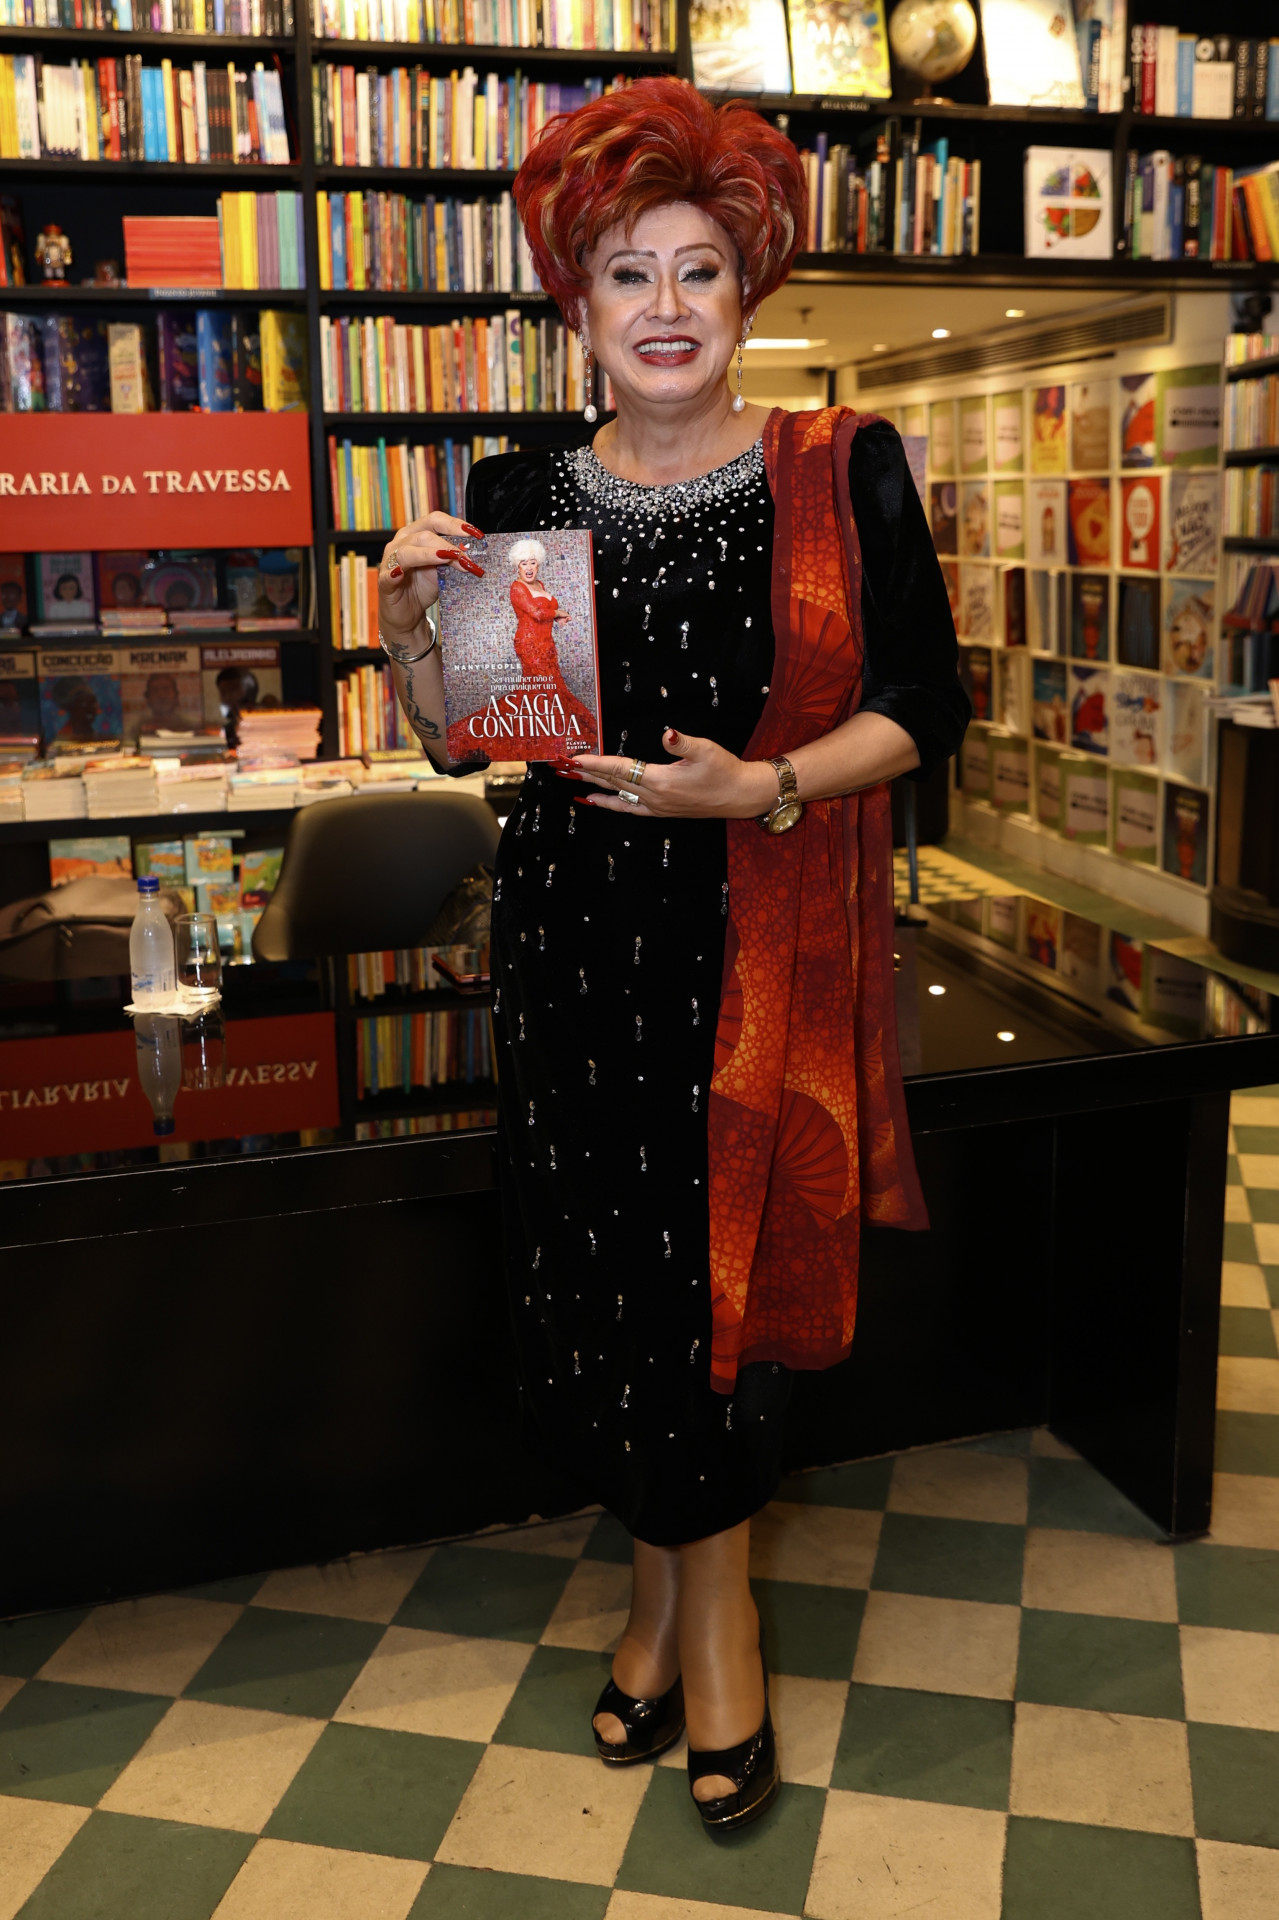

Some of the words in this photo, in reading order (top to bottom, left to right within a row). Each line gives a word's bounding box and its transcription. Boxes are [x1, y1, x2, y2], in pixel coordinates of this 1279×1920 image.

[0, 472, 92, 496] RARIA
[101, 475, 137, 495] DA
[143, 469, 292, 493] TRAVESSA
[130, 650, 188, 665] KRENAK
[490, 684, 507, 692] para
[508, 683, 542, 692] qualquer
[491, 675, 502, 684] Ser
[534, 674, 547, 682] não
[486, 695, 500, 716] A
[504, 693, 565, 716] SAGA
[469, 714, 581, 738] CONTINUA
